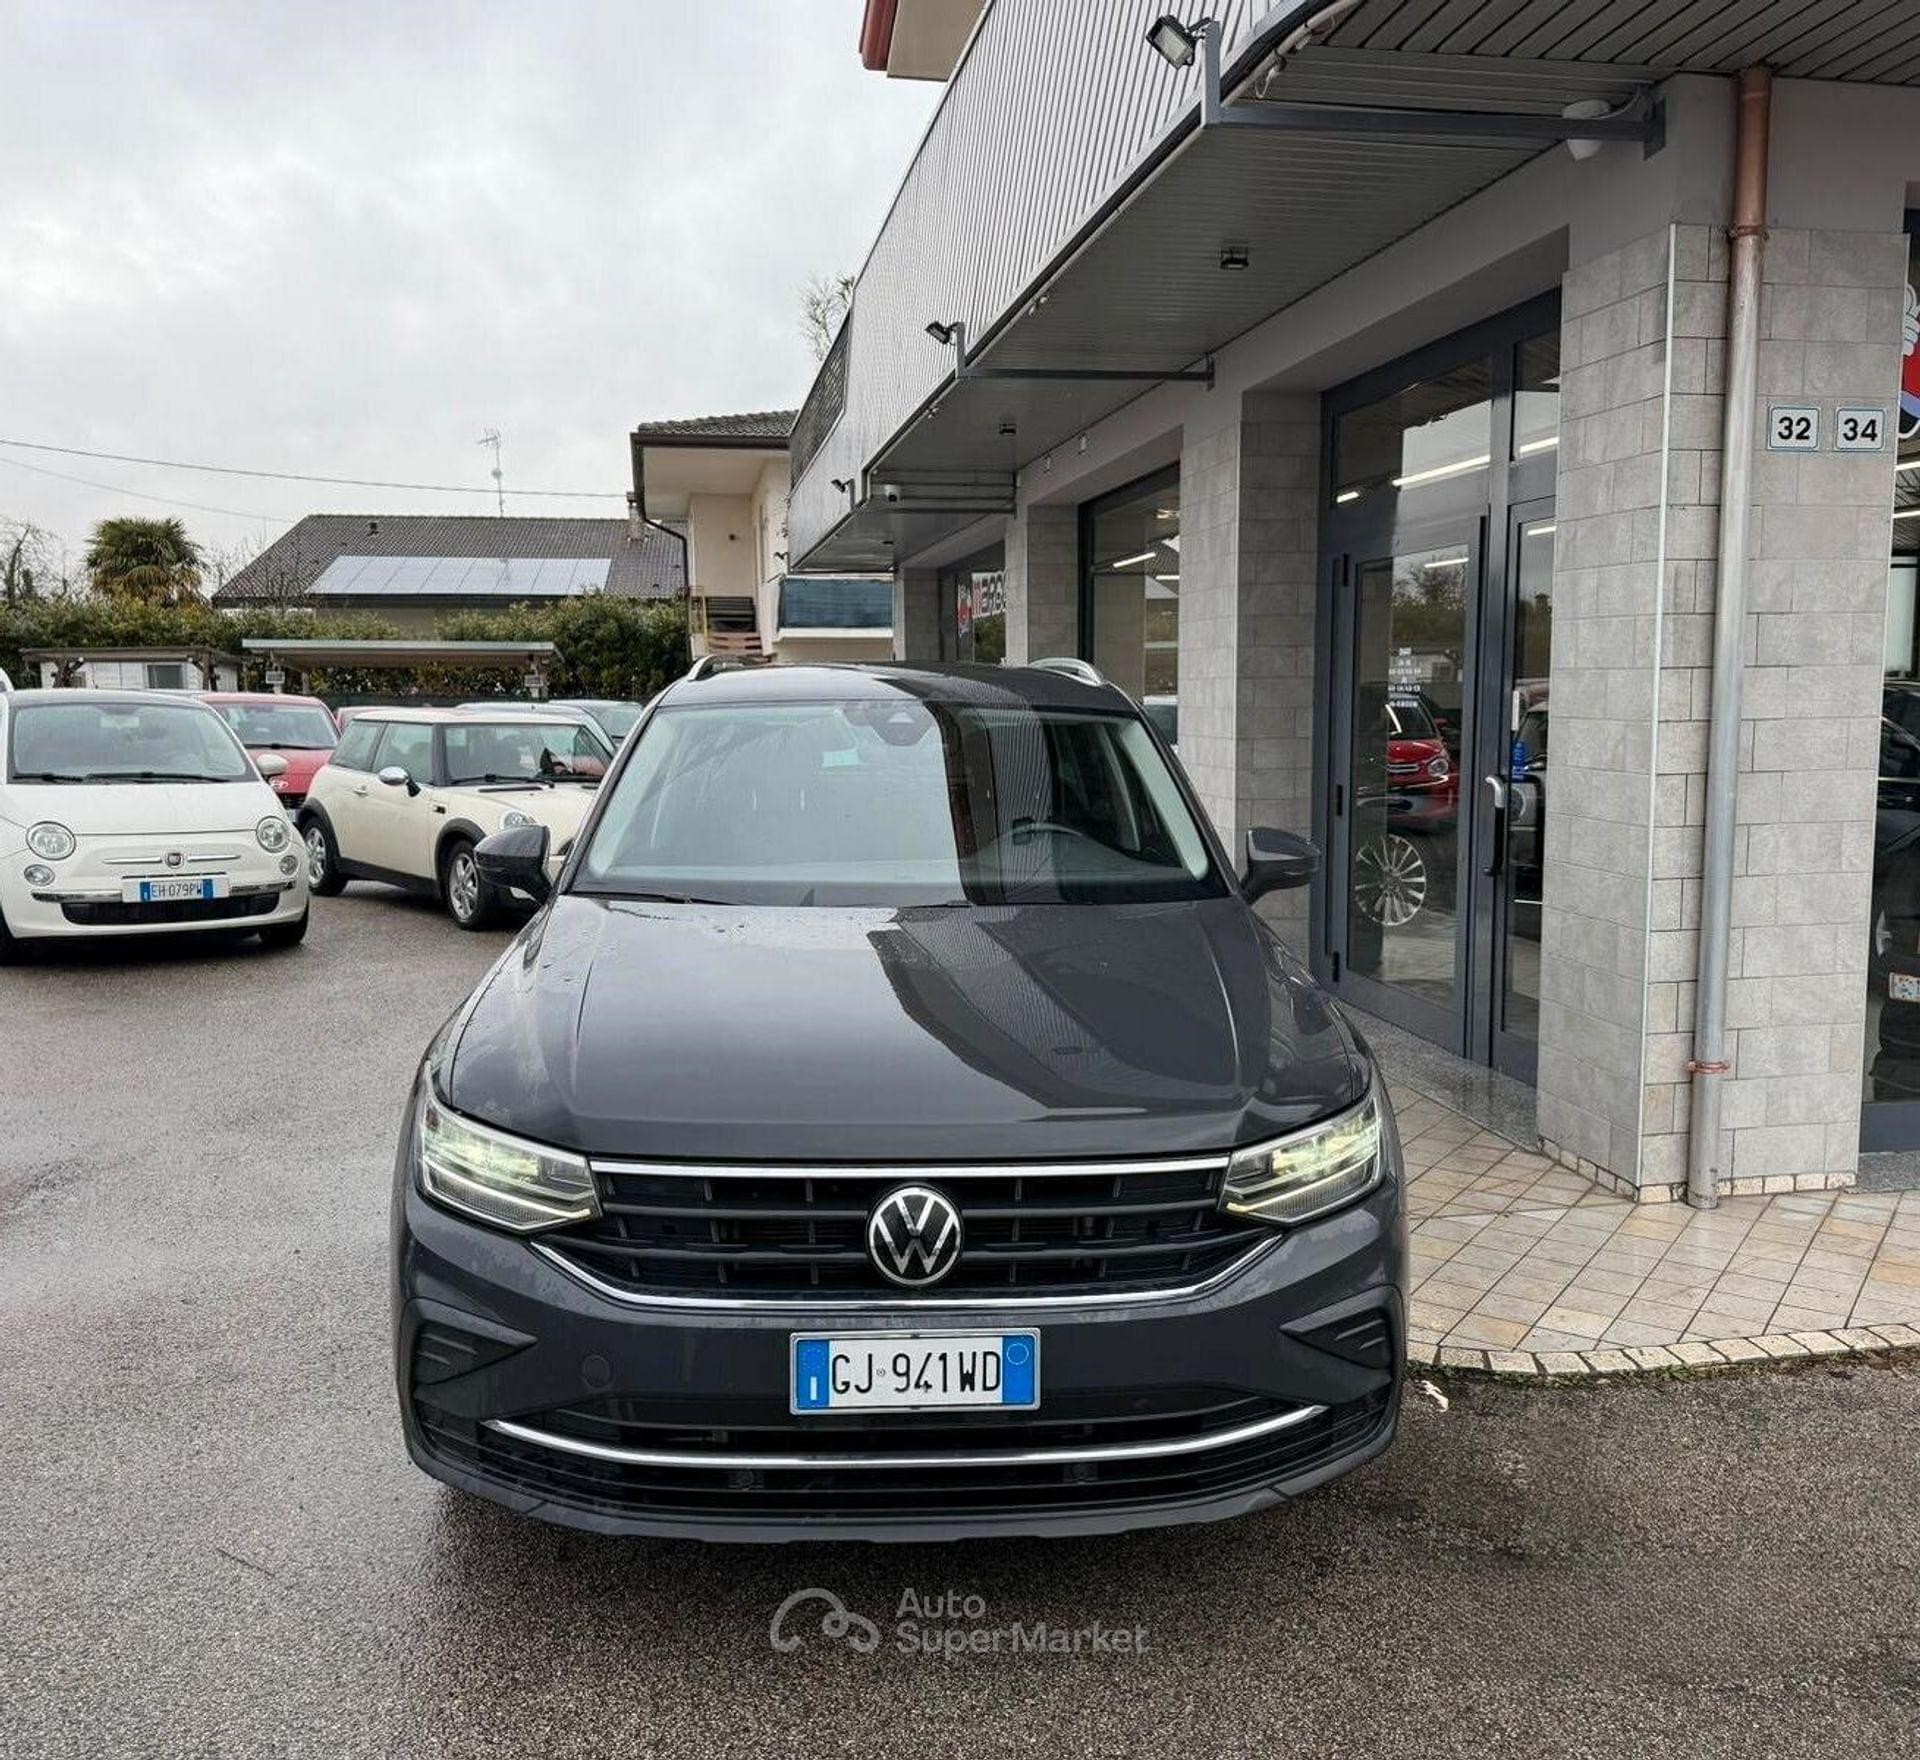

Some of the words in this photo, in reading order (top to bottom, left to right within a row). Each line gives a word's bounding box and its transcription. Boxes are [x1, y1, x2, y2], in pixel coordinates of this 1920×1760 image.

[1778, 416, 1811, 440] 32
[1842, 417, 1878, 442] 34
[831, 1353, 873, 1394] GJ
[891, 1350, 1001, 1393] 941WD
